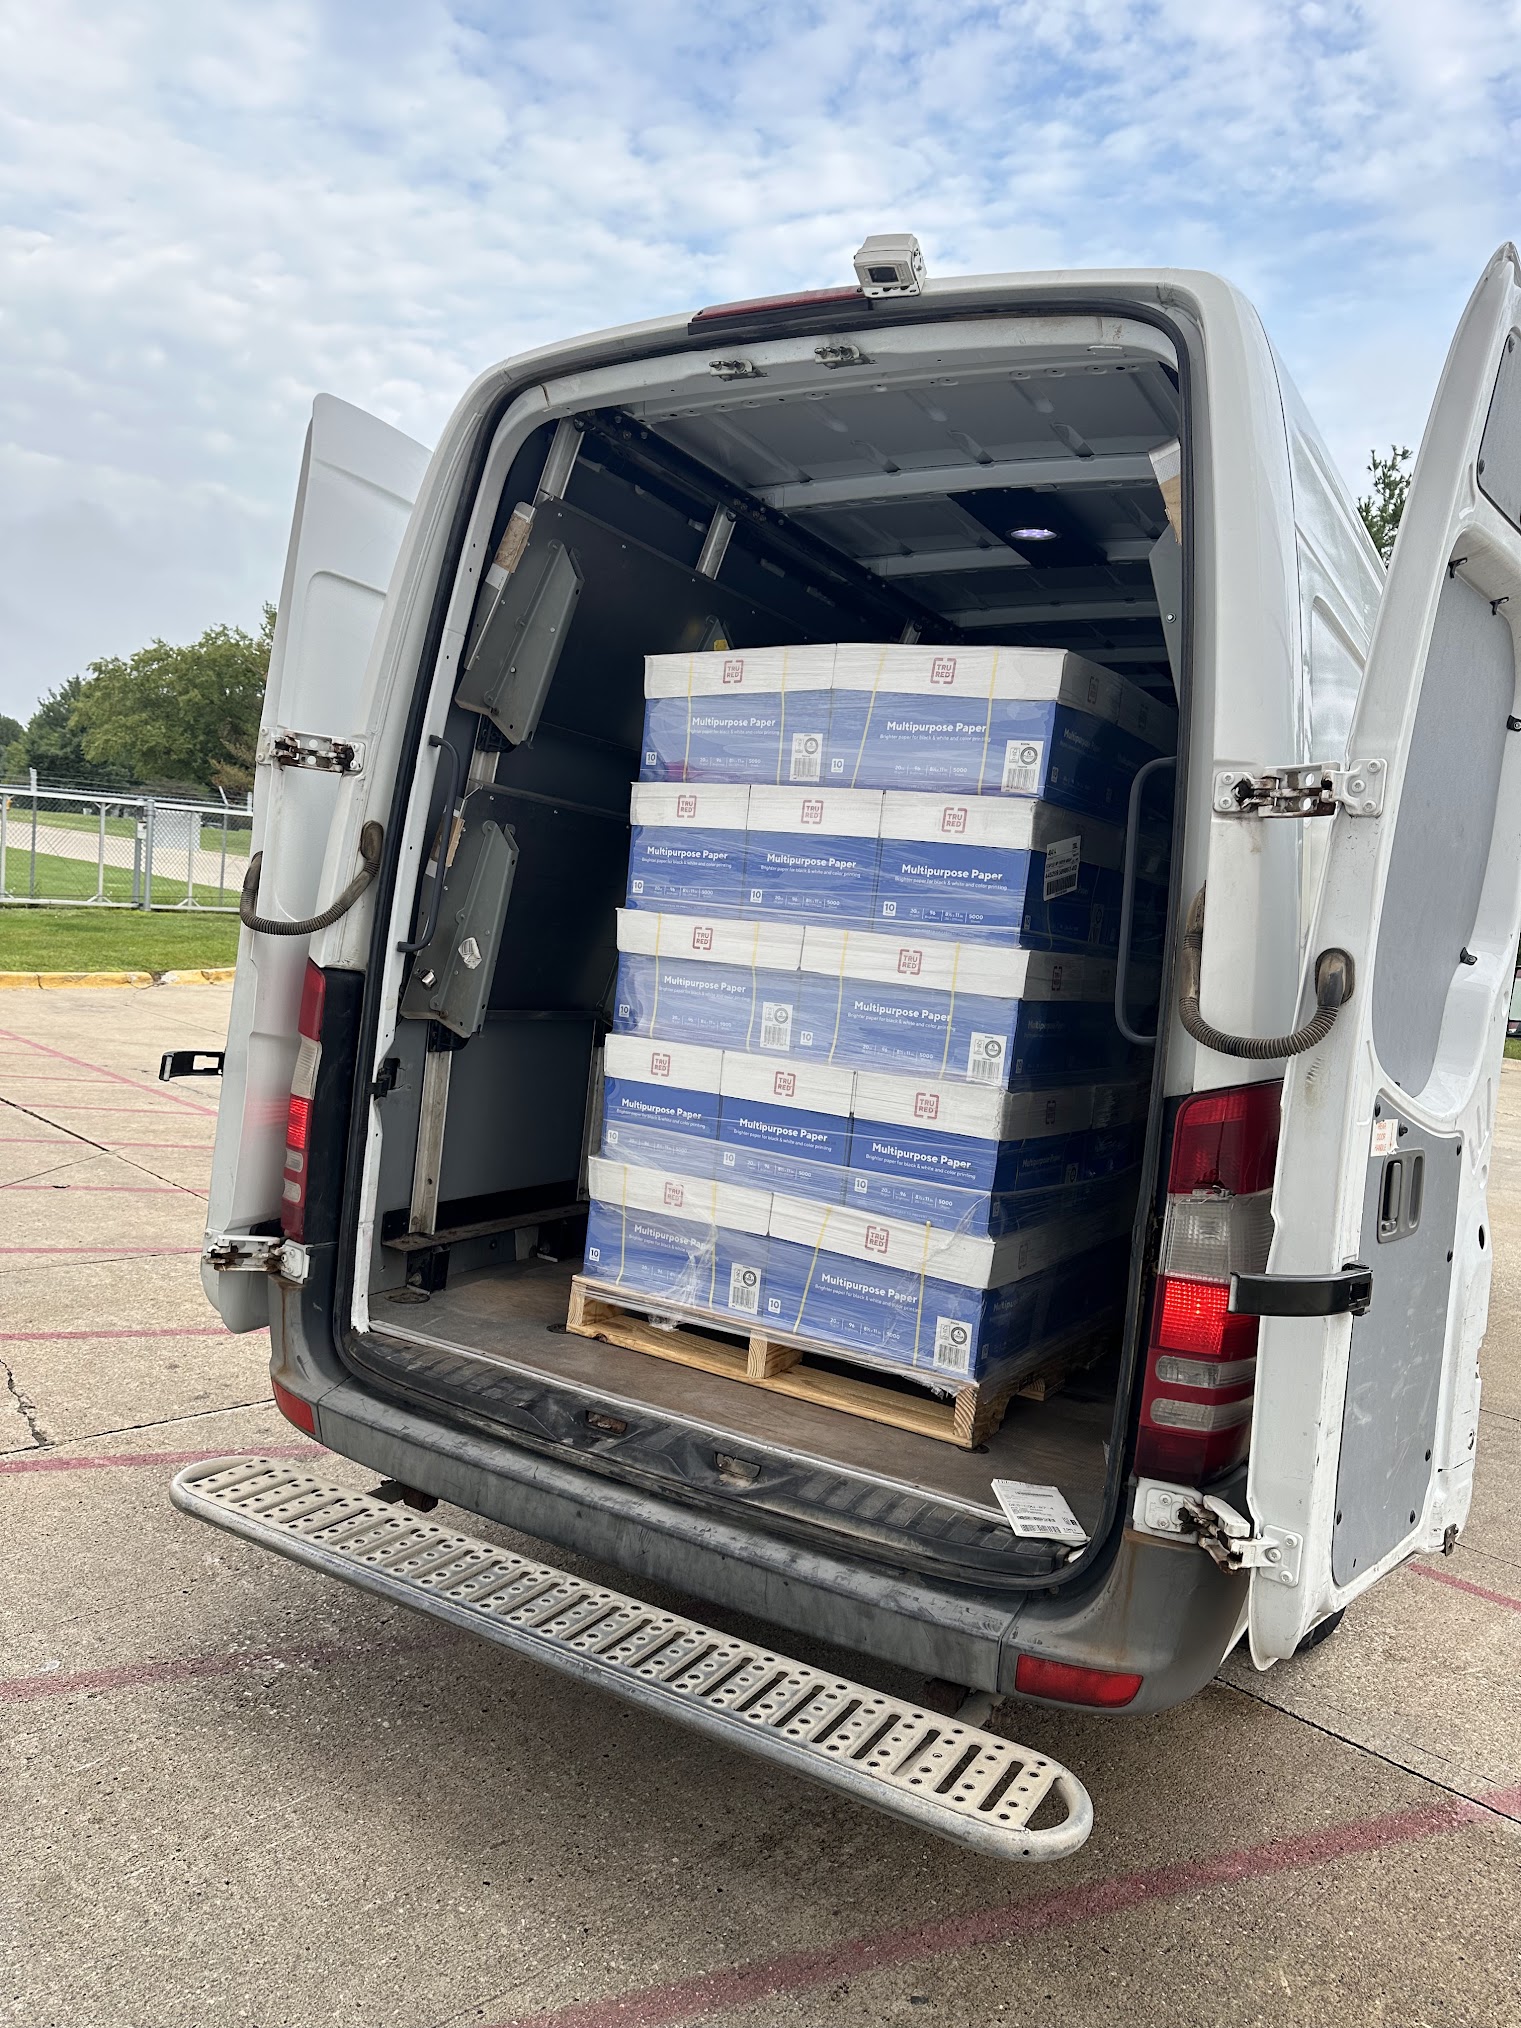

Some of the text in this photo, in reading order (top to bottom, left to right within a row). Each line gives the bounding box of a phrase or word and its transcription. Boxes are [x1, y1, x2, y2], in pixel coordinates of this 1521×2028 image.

[692, 717, 775, 728] Multipurpose Paper
[887, 721, 987, 734] Multipurpose Paper
[647, 753, 655, 761] 10
[647, 847, 728, 861] Multipurpose Paper
[767, 854, 856, 870] Multipurpose Paper
[902, 864, 1003, 881] Multipurpose Paper
[885, 903, 895, 912] 10
[904, 955, 918, 963] TRU
[664, 976, 746, 993] Multipurpose Paper
[854, 1001, 951, 1022] Multipurpose Paper
[802, 1033, 812, 1042] 10
[920, 1099, 935, 1107] TRU
[622, 1098, 701, 1120] Multipurpose Paper
[919, 1106, 934, 1114] RED
[740, 1118, 828, 1142] Multipurpose Paper
[609, 1132, 617, 1140] 10
[725, 1154, 734, 1162] 10
[872, 1143, 971, 1169] Multipurpose Paper
[856, 1180, 866, 1189] 10
[668, 1187, 681, 1195] TRU
[634, 1225, 689, 1245] Multipurpose
[870, 1231, 885, 1240] TRU
[869, 1239, 884, 1247] RED
[591, 1249, 599, 1257] 10
[822, 1273, 917, 1303] Multipurpose Paper
[770, 1300, 779, 1309] 10
